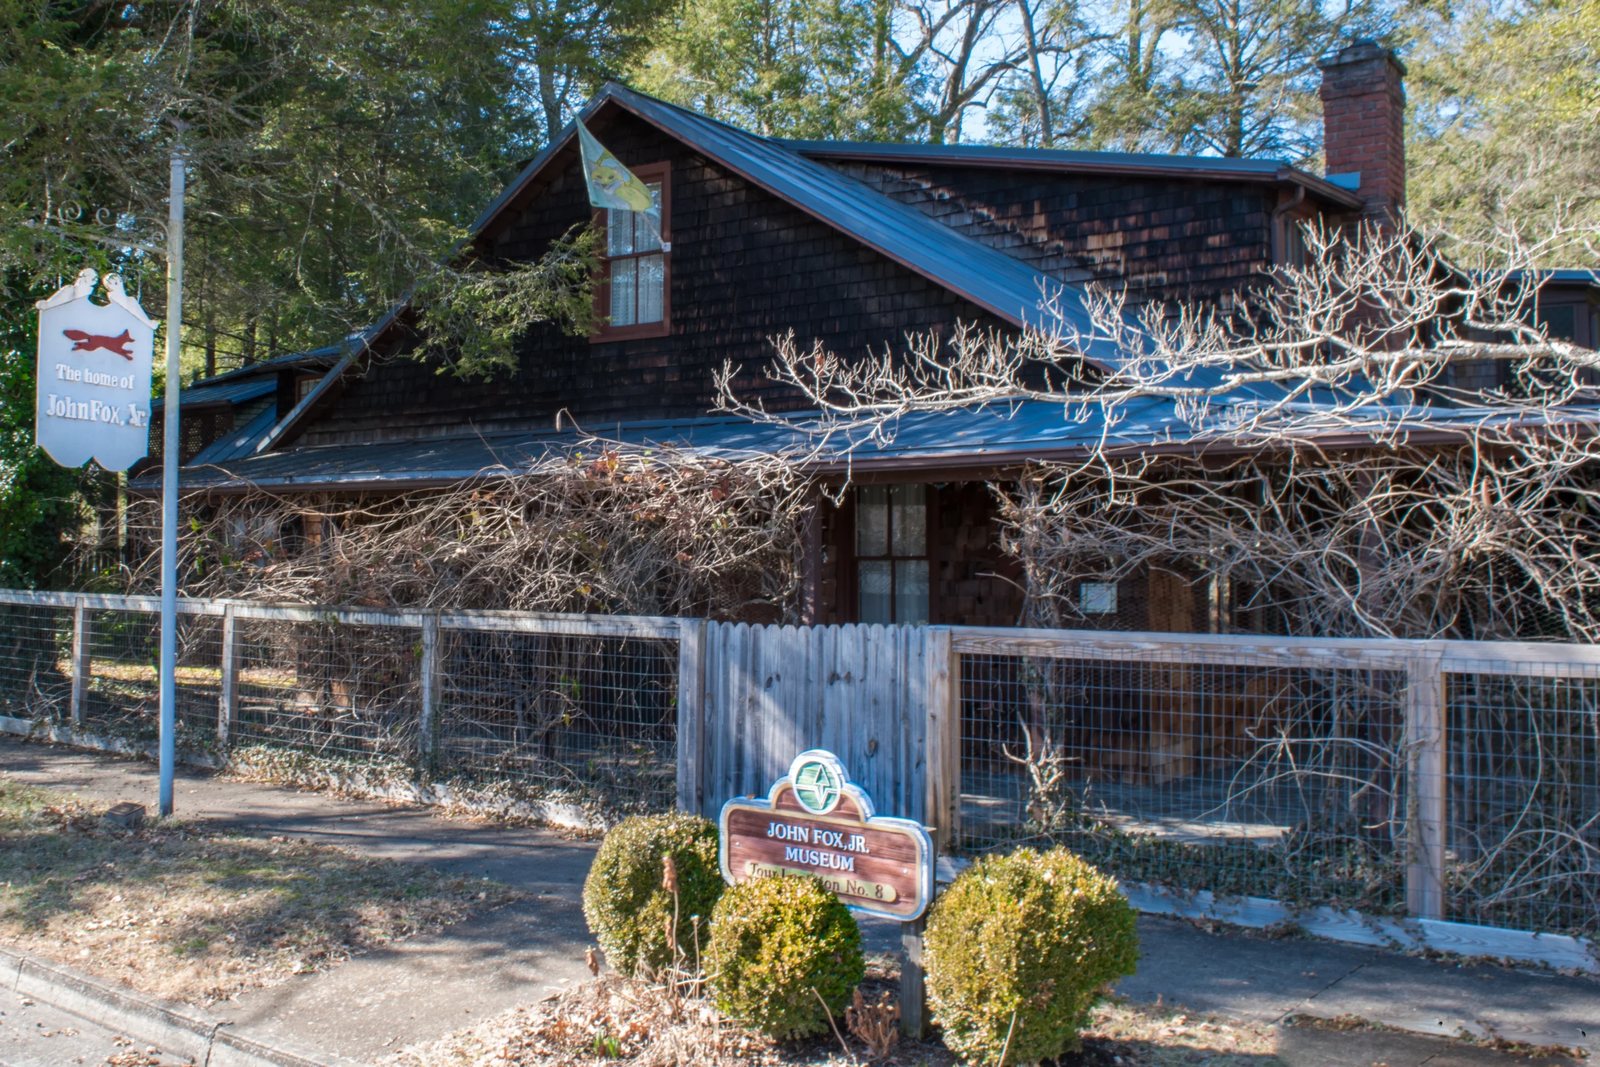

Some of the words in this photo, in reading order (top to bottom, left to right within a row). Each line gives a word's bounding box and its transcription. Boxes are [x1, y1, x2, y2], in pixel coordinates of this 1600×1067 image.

[55, 363, 81, 381] The
[83, 368, 118, 387] home
[120, 374, 135, 389] of
[767, 822, 809, 843] JOHN
[785, 846, 854, 872] MUSEUM
[846, 879, 869, 896] No.
[875, 884, 883, 899] 8
